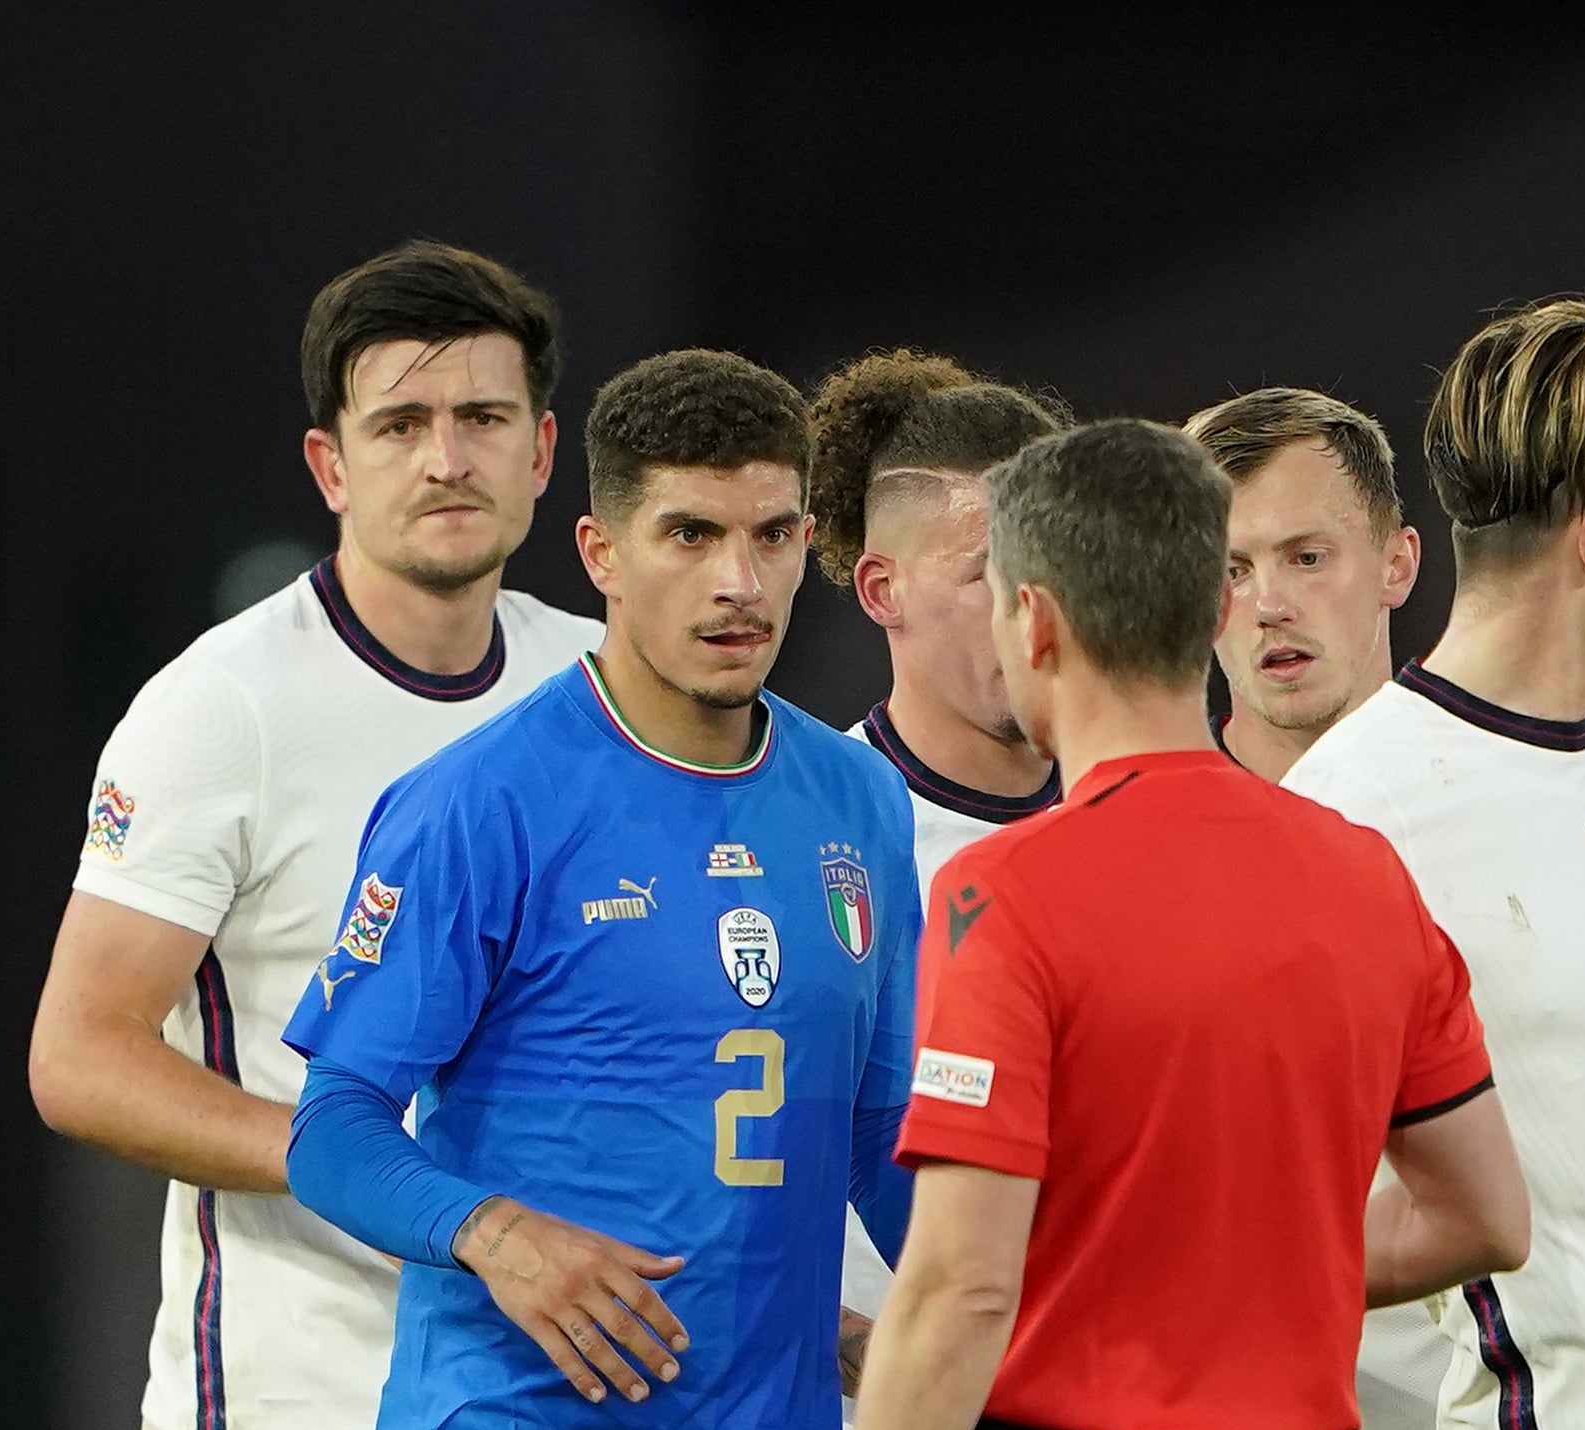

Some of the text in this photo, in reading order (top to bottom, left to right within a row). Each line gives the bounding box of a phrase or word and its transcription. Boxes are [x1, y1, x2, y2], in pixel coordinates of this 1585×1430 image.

[825, 867, 865, 886] ITALIA
[582, 897, 649, 924] PUMA
[728, 927, 767, 935] EUROPEAN
[729, 935, 769, 943] CHAMPIONS
[746, 987, 766, 996] 2020
[714, 1029, 786, 1186] 2
